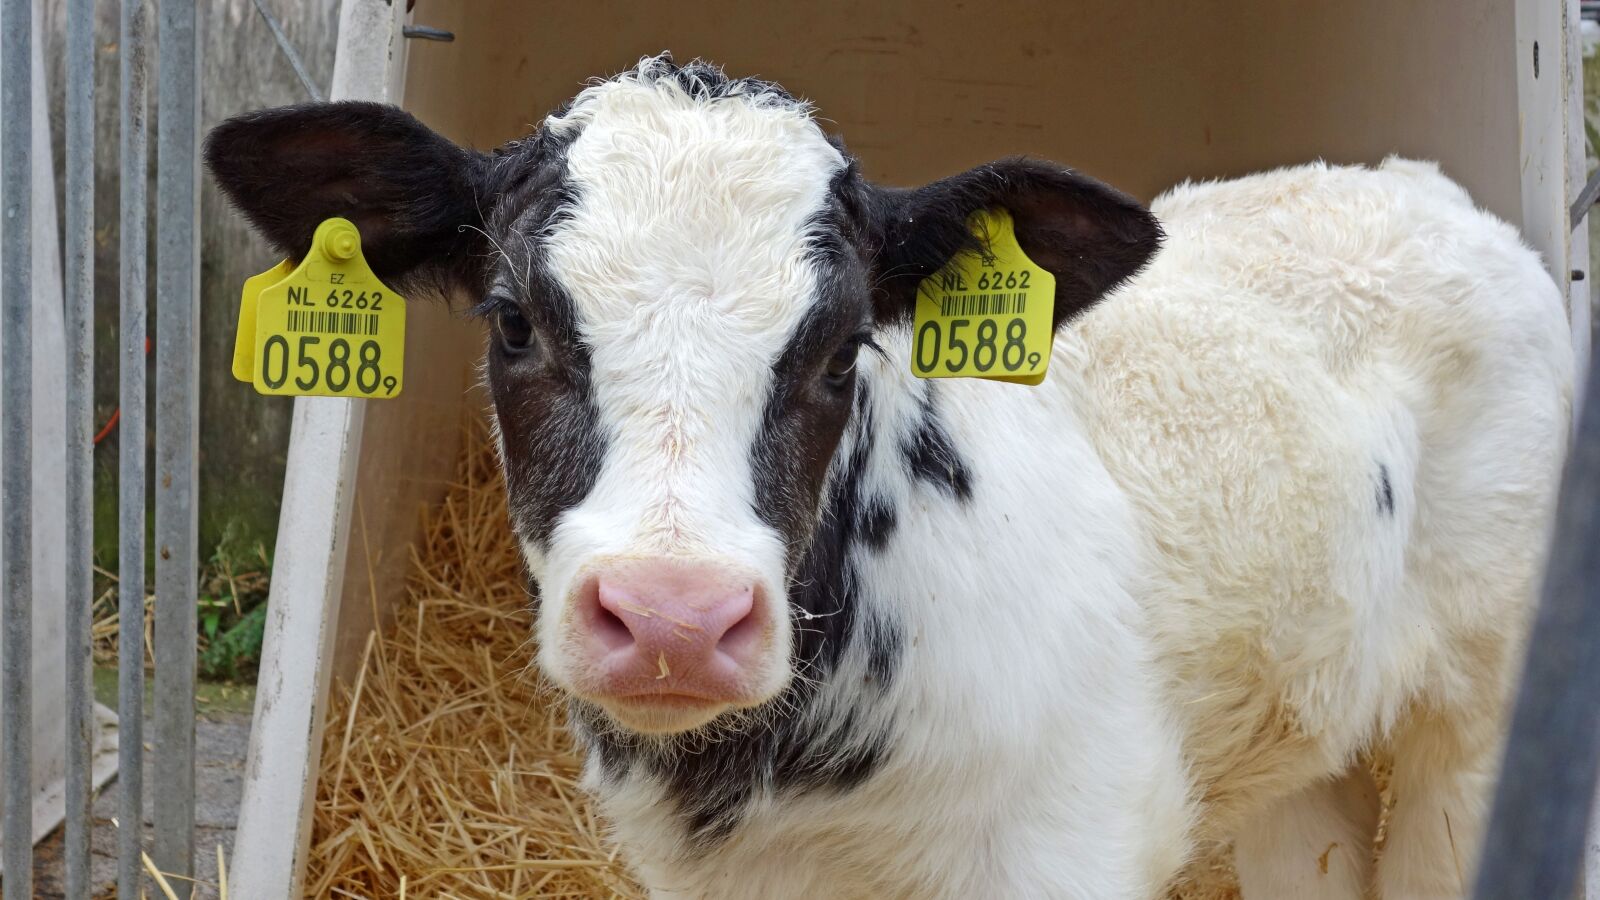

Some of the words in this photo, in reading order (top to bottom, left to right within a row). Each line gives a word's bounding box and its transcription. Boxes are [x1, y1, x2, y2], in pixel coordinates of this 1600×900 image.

[330, 273, 345, 285] EZ
[942, 271, 968, 292] NL
[977, 270, 1031, 290] 6262
[287, 286, 316, 307] NL
[326, 289, 383, 311] 6262
